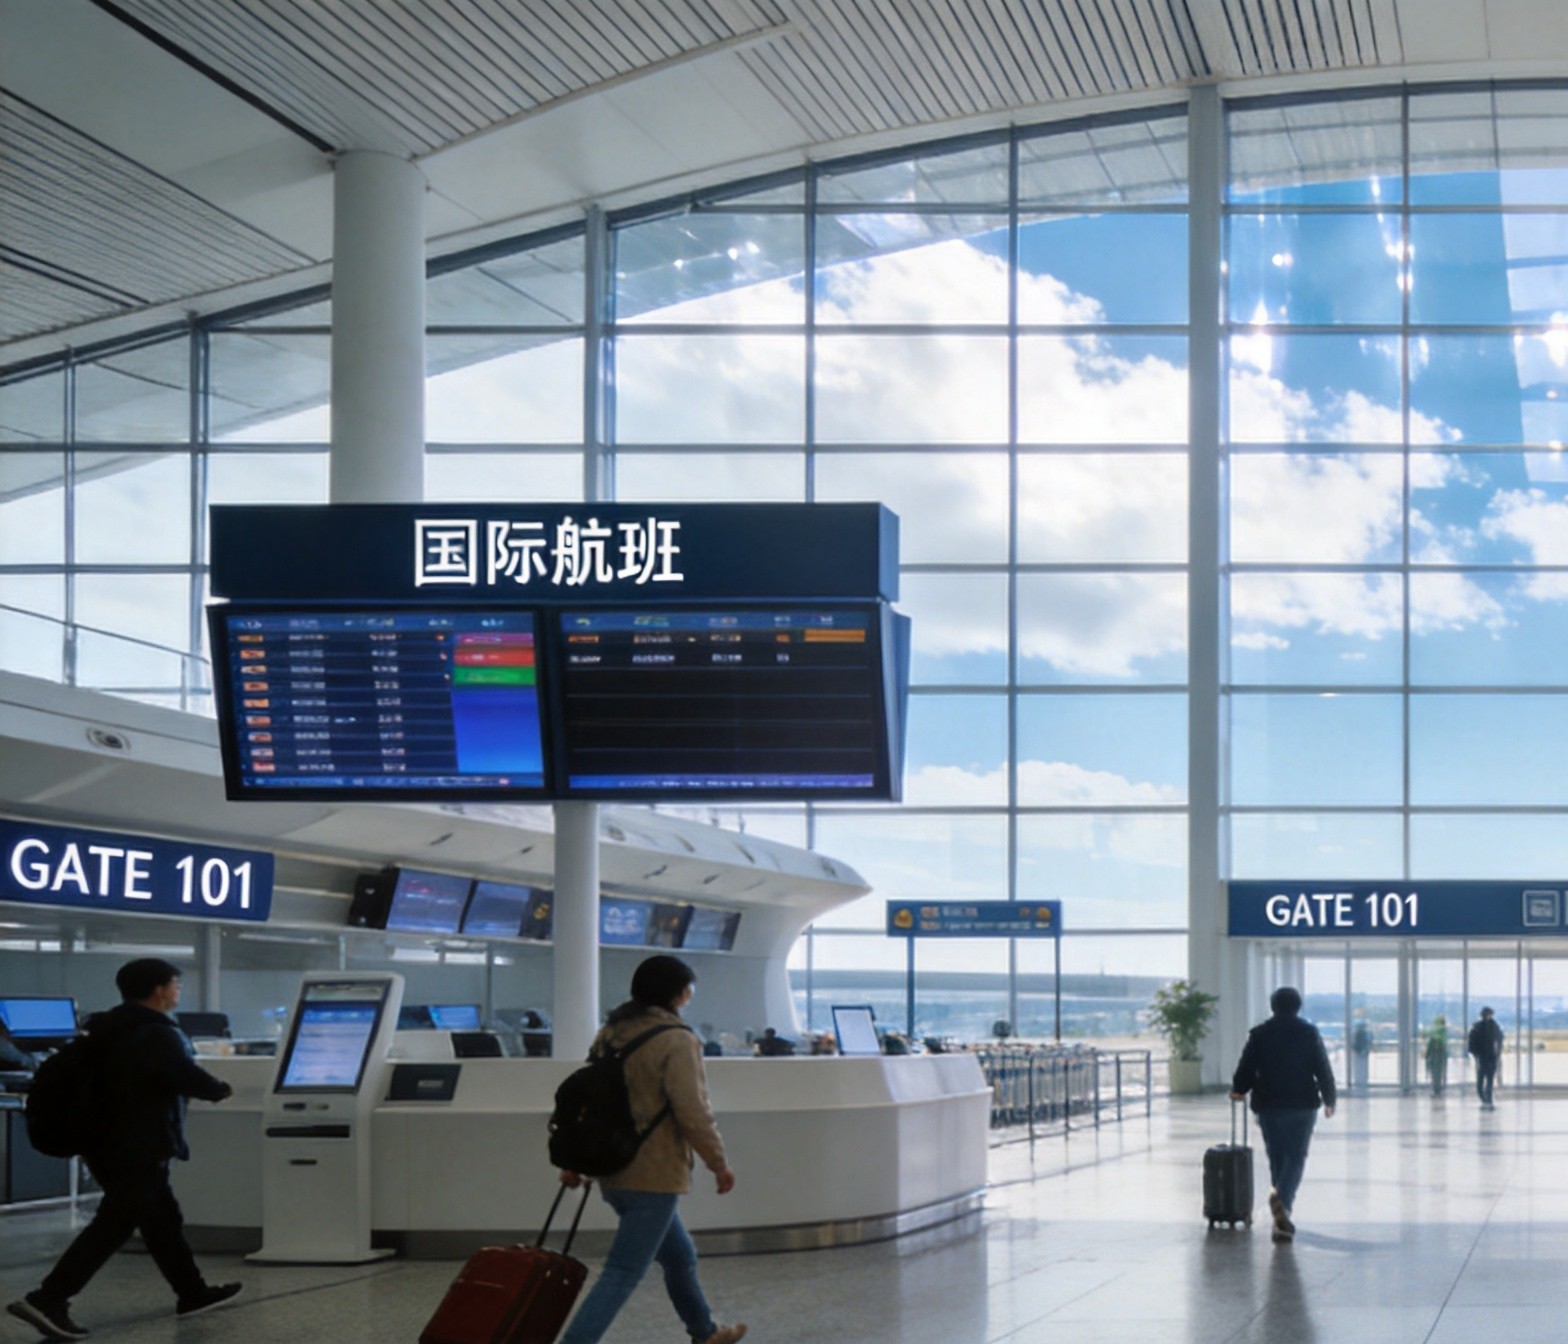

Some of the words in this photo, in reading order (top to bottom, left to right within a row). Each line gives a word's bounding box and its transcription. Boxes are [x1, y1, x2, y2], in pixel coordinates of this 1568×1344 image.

[414, 516, 684, 587] 国际航班
[10, 838, 153, 900] GATE
[175, 855, 252, 909] 101
[1265, 893, 1354, 926] GATE
[1366, 892, 1418, 927] 101
